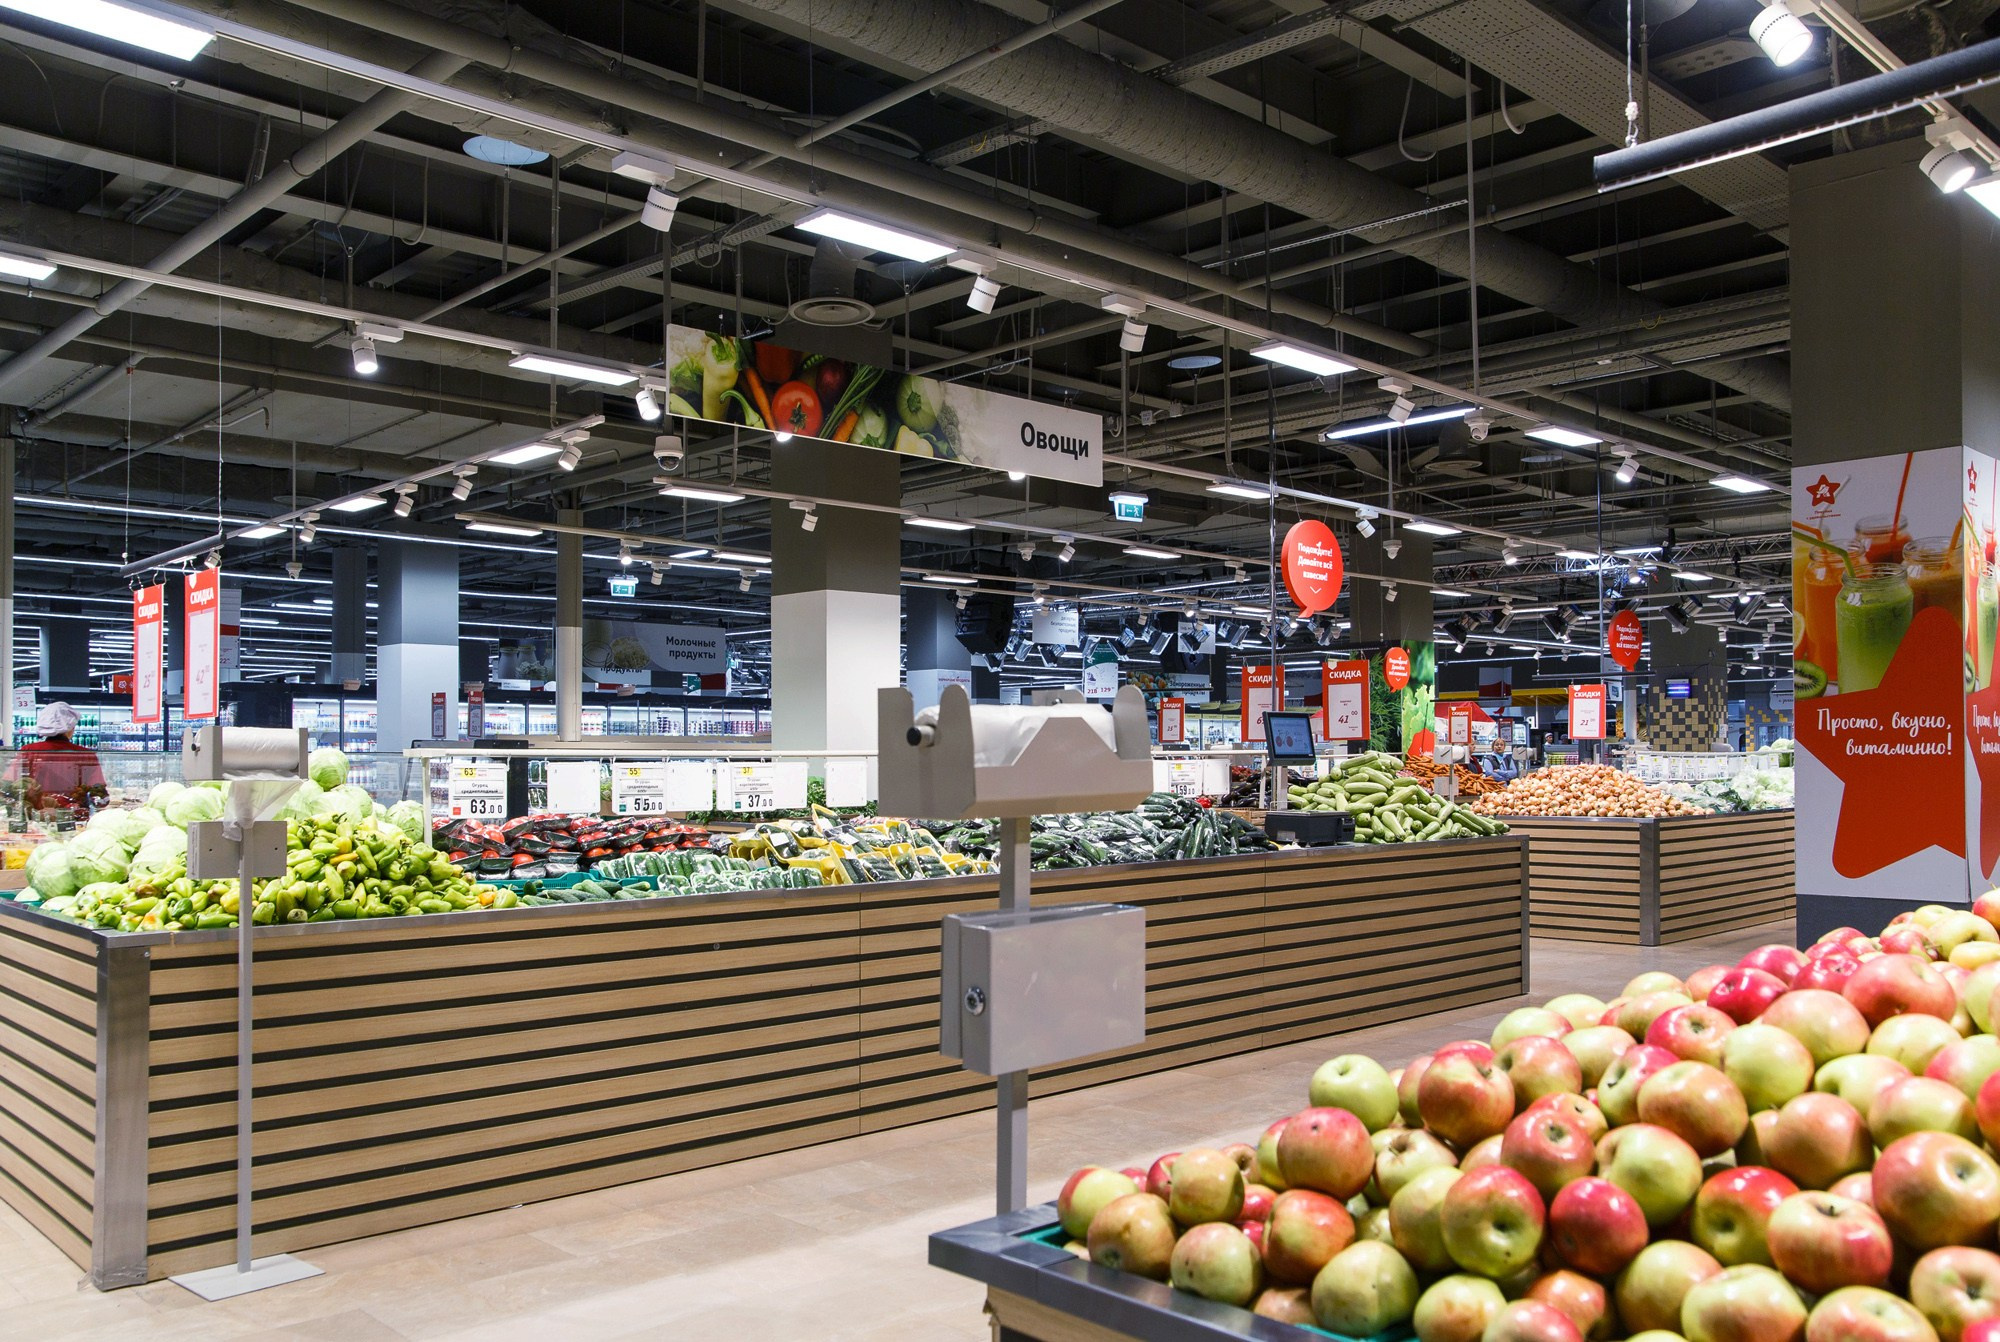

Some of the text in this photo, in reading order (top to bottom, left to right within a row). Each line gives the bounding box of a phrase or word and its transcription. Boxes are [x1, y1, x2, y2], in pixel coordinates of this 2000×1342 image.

[1020, 421, 1089, 460] Овощи
[1297, 542, 1333, 557] Подождите!
[1297, 555, 1333, 569] Давайте всё
[190, 587, 215, 605] СКИДКА
[138, 602, 159, 619] СКИДКА
[665, 636, 716, 648] Молочные
[669, 649, 716, 660] продукты
[1329, 669, 1362, 680] СКИДКА
[1574, 691, 1601, 699] СКИДКИ
[1338, 715, 1349, 723] 41
[1816, 708, 1952, 738] Просто, вкусно,
[1846, 732, 1952, 756] витаминно!
[464, 767, 474, 776] 63
[629, 767, 638, 776] 55
